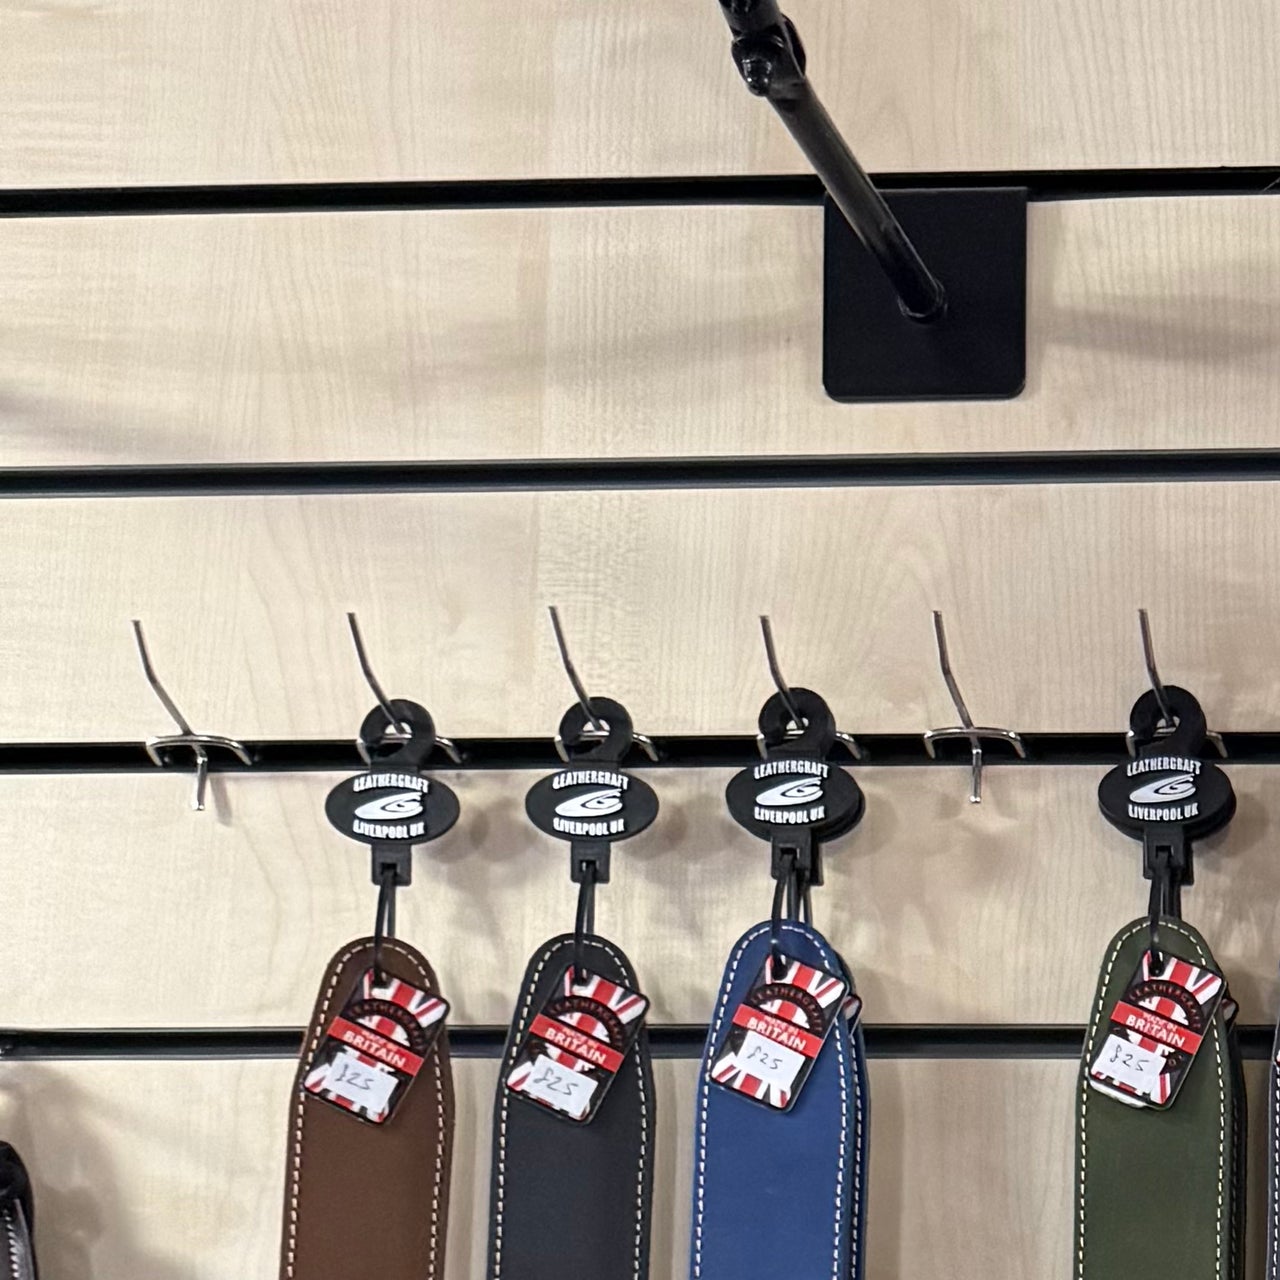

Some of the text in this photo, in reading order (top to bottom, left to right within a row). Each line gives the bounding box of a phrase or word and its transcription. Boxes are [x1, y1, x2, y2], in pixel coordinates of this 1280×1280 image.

[754, 760, 828, 779] LEATHERCRAFT
[1126, 757, 1201, 777] LEATHERCRAFT
[353, 773, 429, 793] LEATHERCRAFT
[552, 770, 629, 790] LEATHERCRAFT
[754, 806, 825, 824] LIVERPOOL UK
[1128, 802, 1199, 821] LIVERPOOL UK
[353, 820, 425, 839] LIVERPOOL UK
[553, 817, 625, 836] LIVERPOOL UK
[747, 1016, 807, 1050] BRITAIN
[1126, 1014, 1185, 1047] BRITAIN
[343, 1031, 406, 1068] BRITAIN
[545, 1028, 607, 1064] BRITAIN
